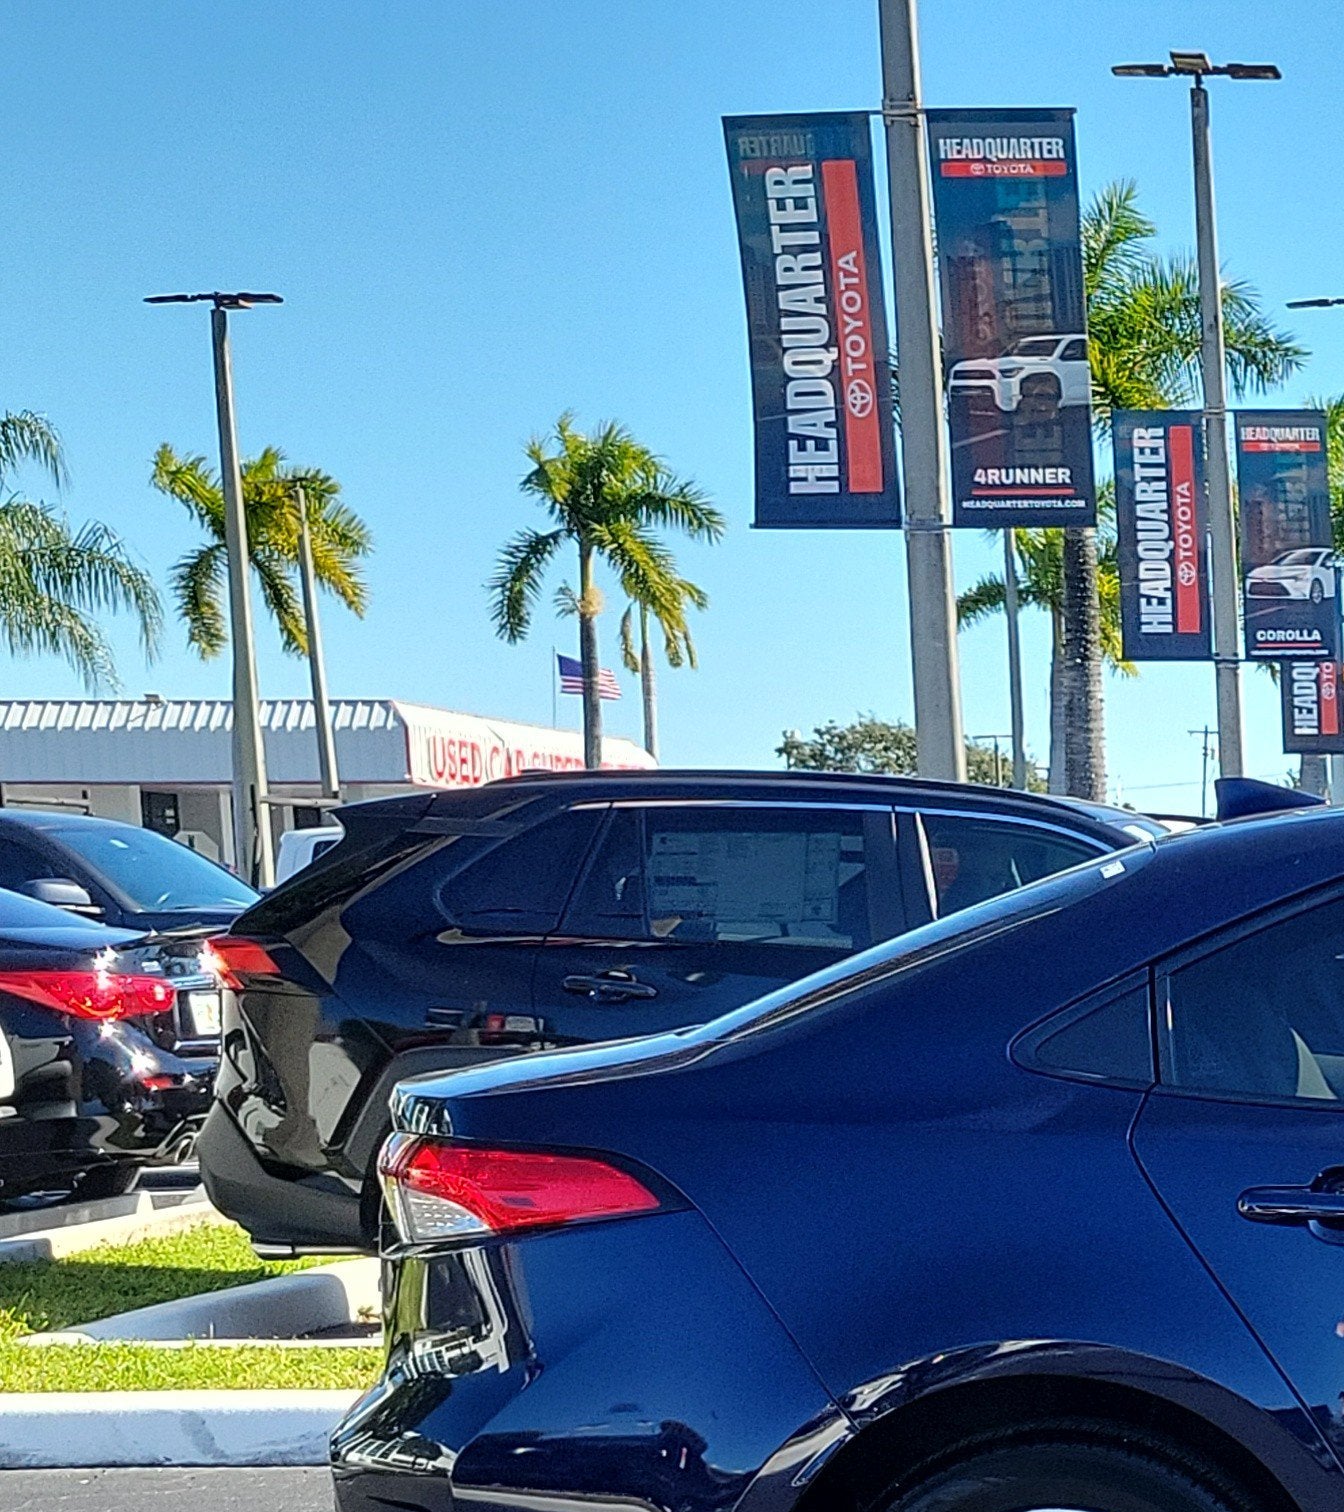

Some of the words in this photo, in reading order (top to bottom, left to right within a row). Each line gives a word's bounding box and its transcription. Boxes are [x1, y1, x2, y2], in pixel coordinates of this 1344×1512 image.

[939, 137, 1065, 162] HEADQUARTER
[986, 164, 1034, 174] TOYOTA
[765, 164, 841, 494] HEADQUARTER
[837, 251, 867, 375] TOYOTA
[1241, 427, 1320, 443] HEADQUARTER
[973, 466, 1071, 485] 4RUNNER
[1133, 427, 1174, 634] HEADQUARTER
[1176, 482, 1191, 559] TOYOTA
[1256, 629, 1322, 641] COROLLA
[430, 735, 483, 784] USED
